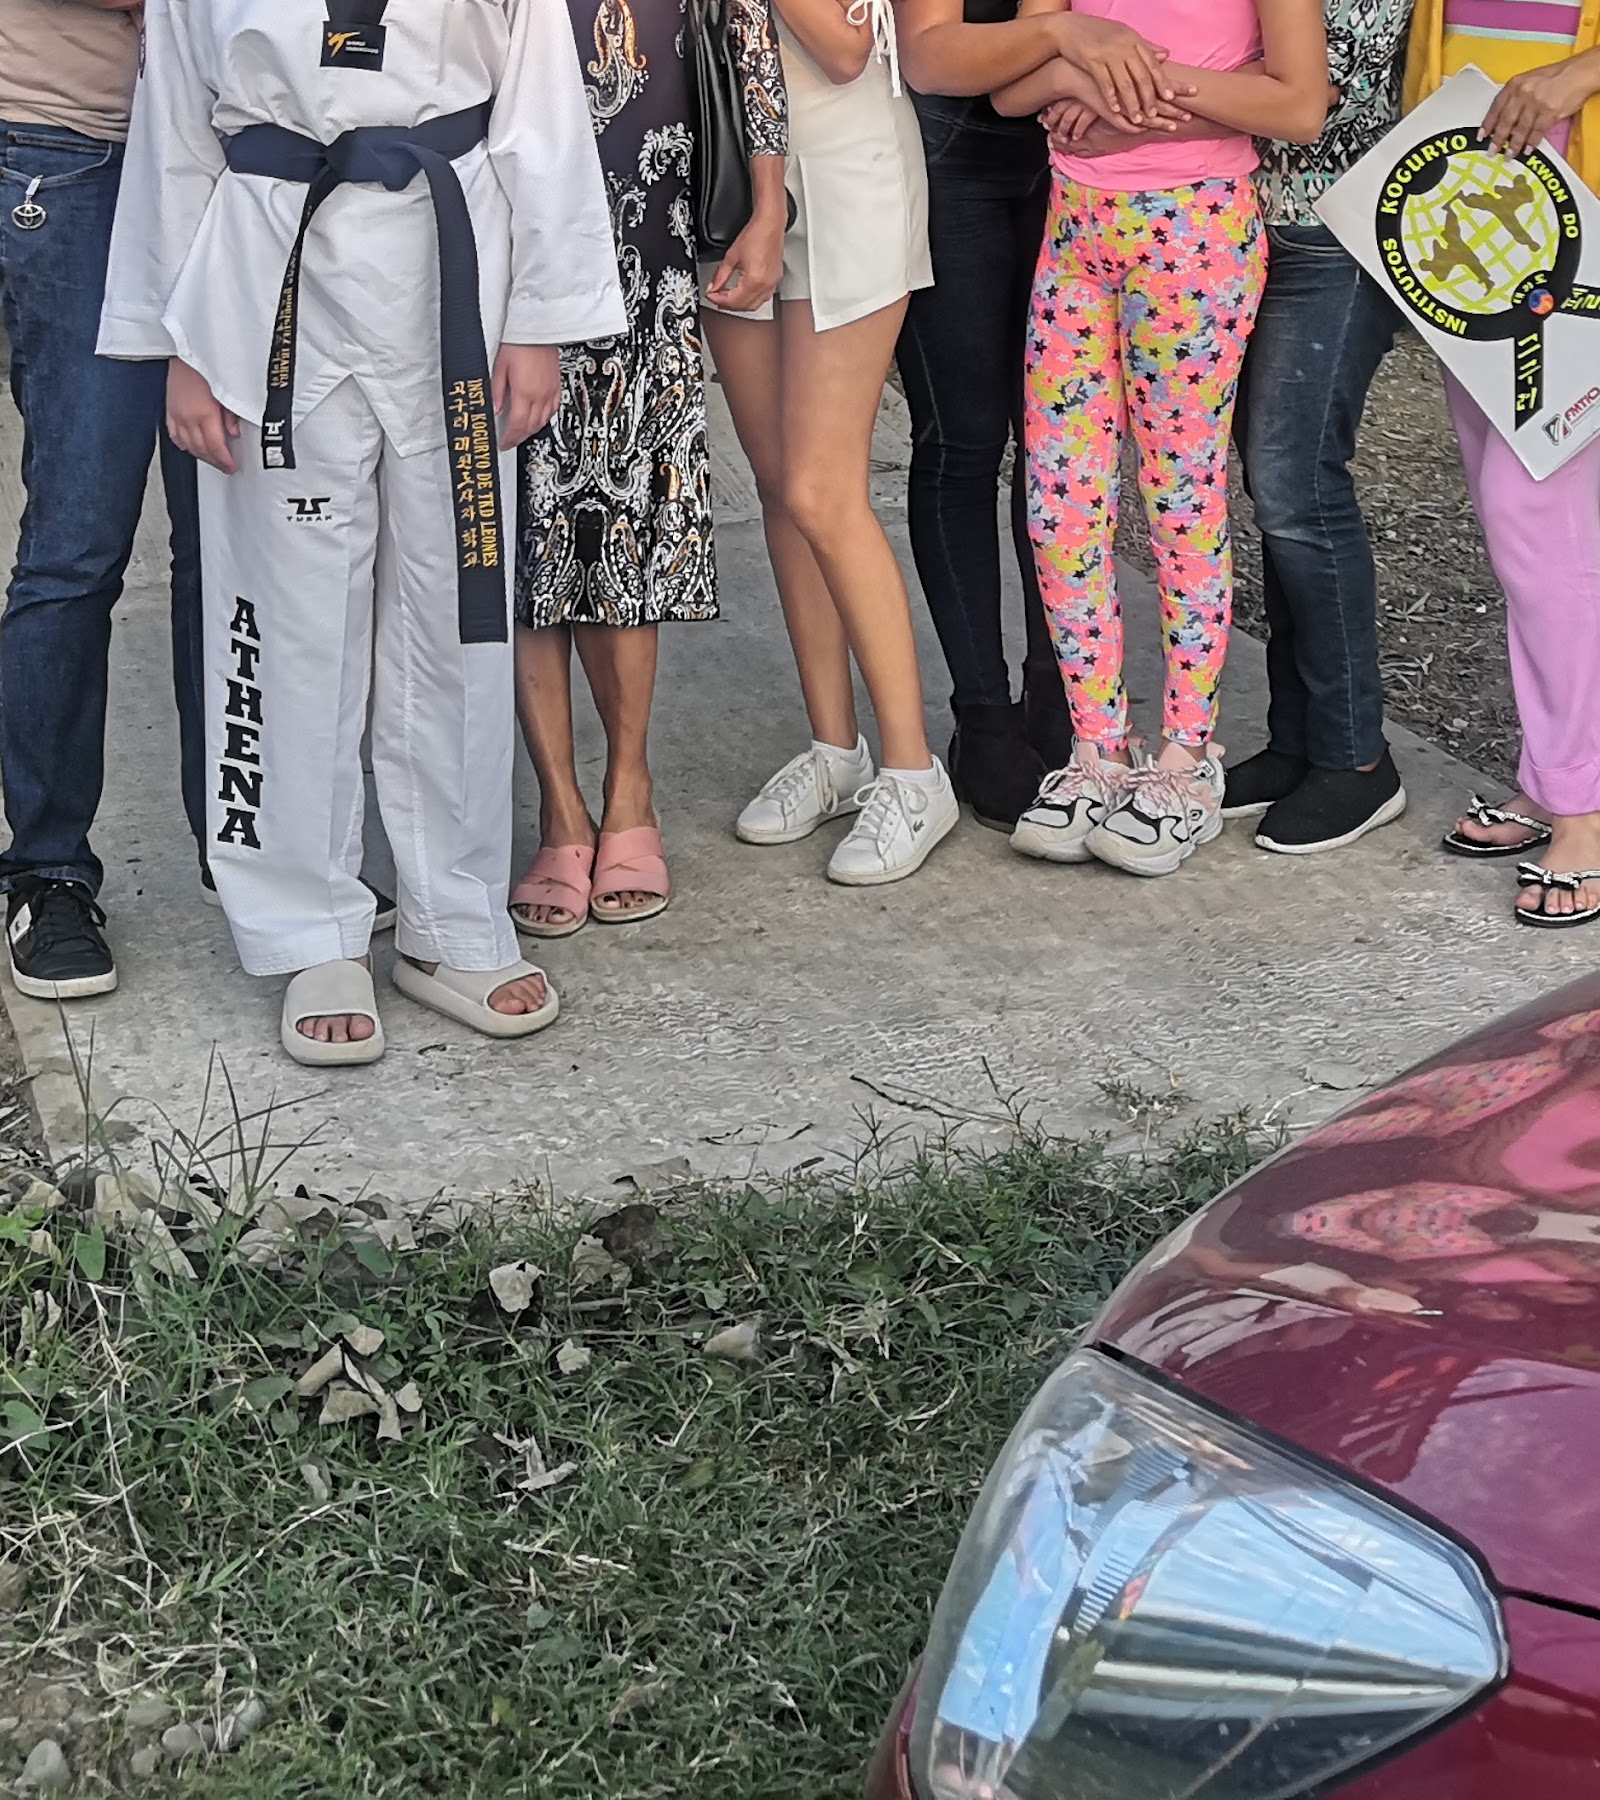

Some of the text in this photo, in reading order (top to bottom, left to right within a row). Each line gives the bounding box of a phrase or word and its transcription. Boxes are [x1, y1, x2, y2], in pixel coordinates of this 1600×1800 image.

[1380, 134, 1468, 214] KOGURYO
[1526, 155, 1569, 203] KWON
[1562, 212, 1579, 239] DO
[1382, 237, 1468, 335] INSTITUTOS
[466, 378, 499, 569] INST. KOGURYO DE TKD LEONES
[216, 595, 264, 851] ATHENA
